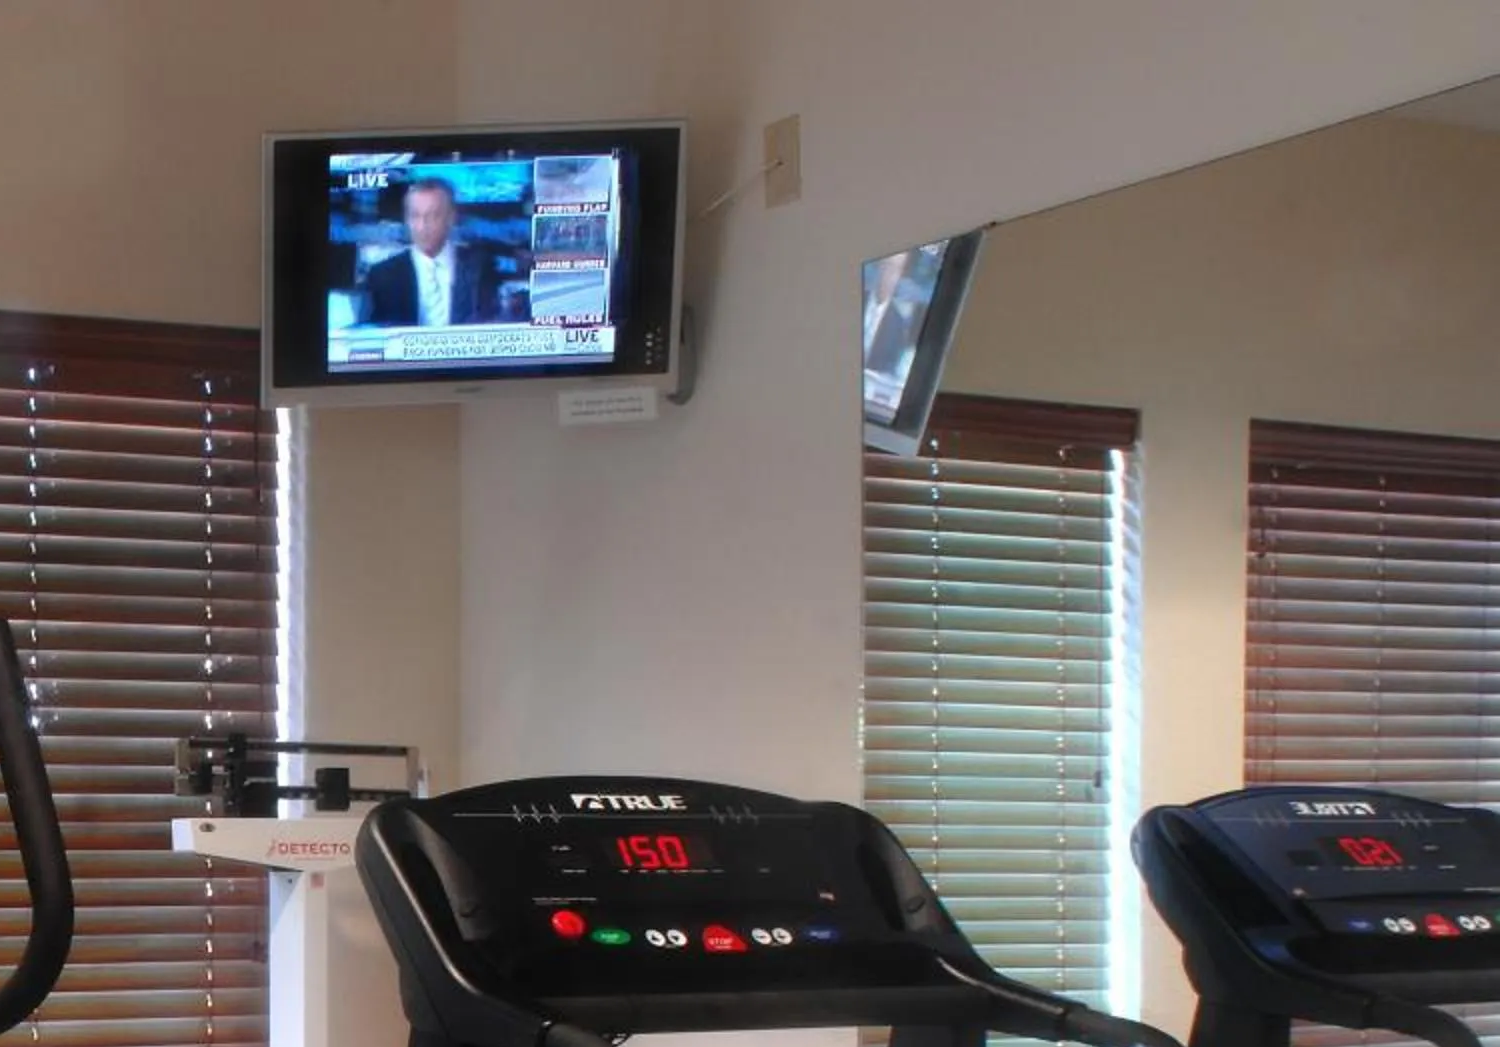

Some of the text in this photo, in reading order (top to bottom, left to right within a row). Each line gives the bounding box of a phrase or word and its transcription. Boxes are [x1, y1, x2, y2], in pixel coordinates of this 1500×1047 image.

[347, 173, 388, 188] LIVE
[565, 329, 599, 342] LIVE
[604, 795, 688, 810] TRUE
[278, 842, 351, 856] DETECTO
[616, 835, 690, 868] 150
